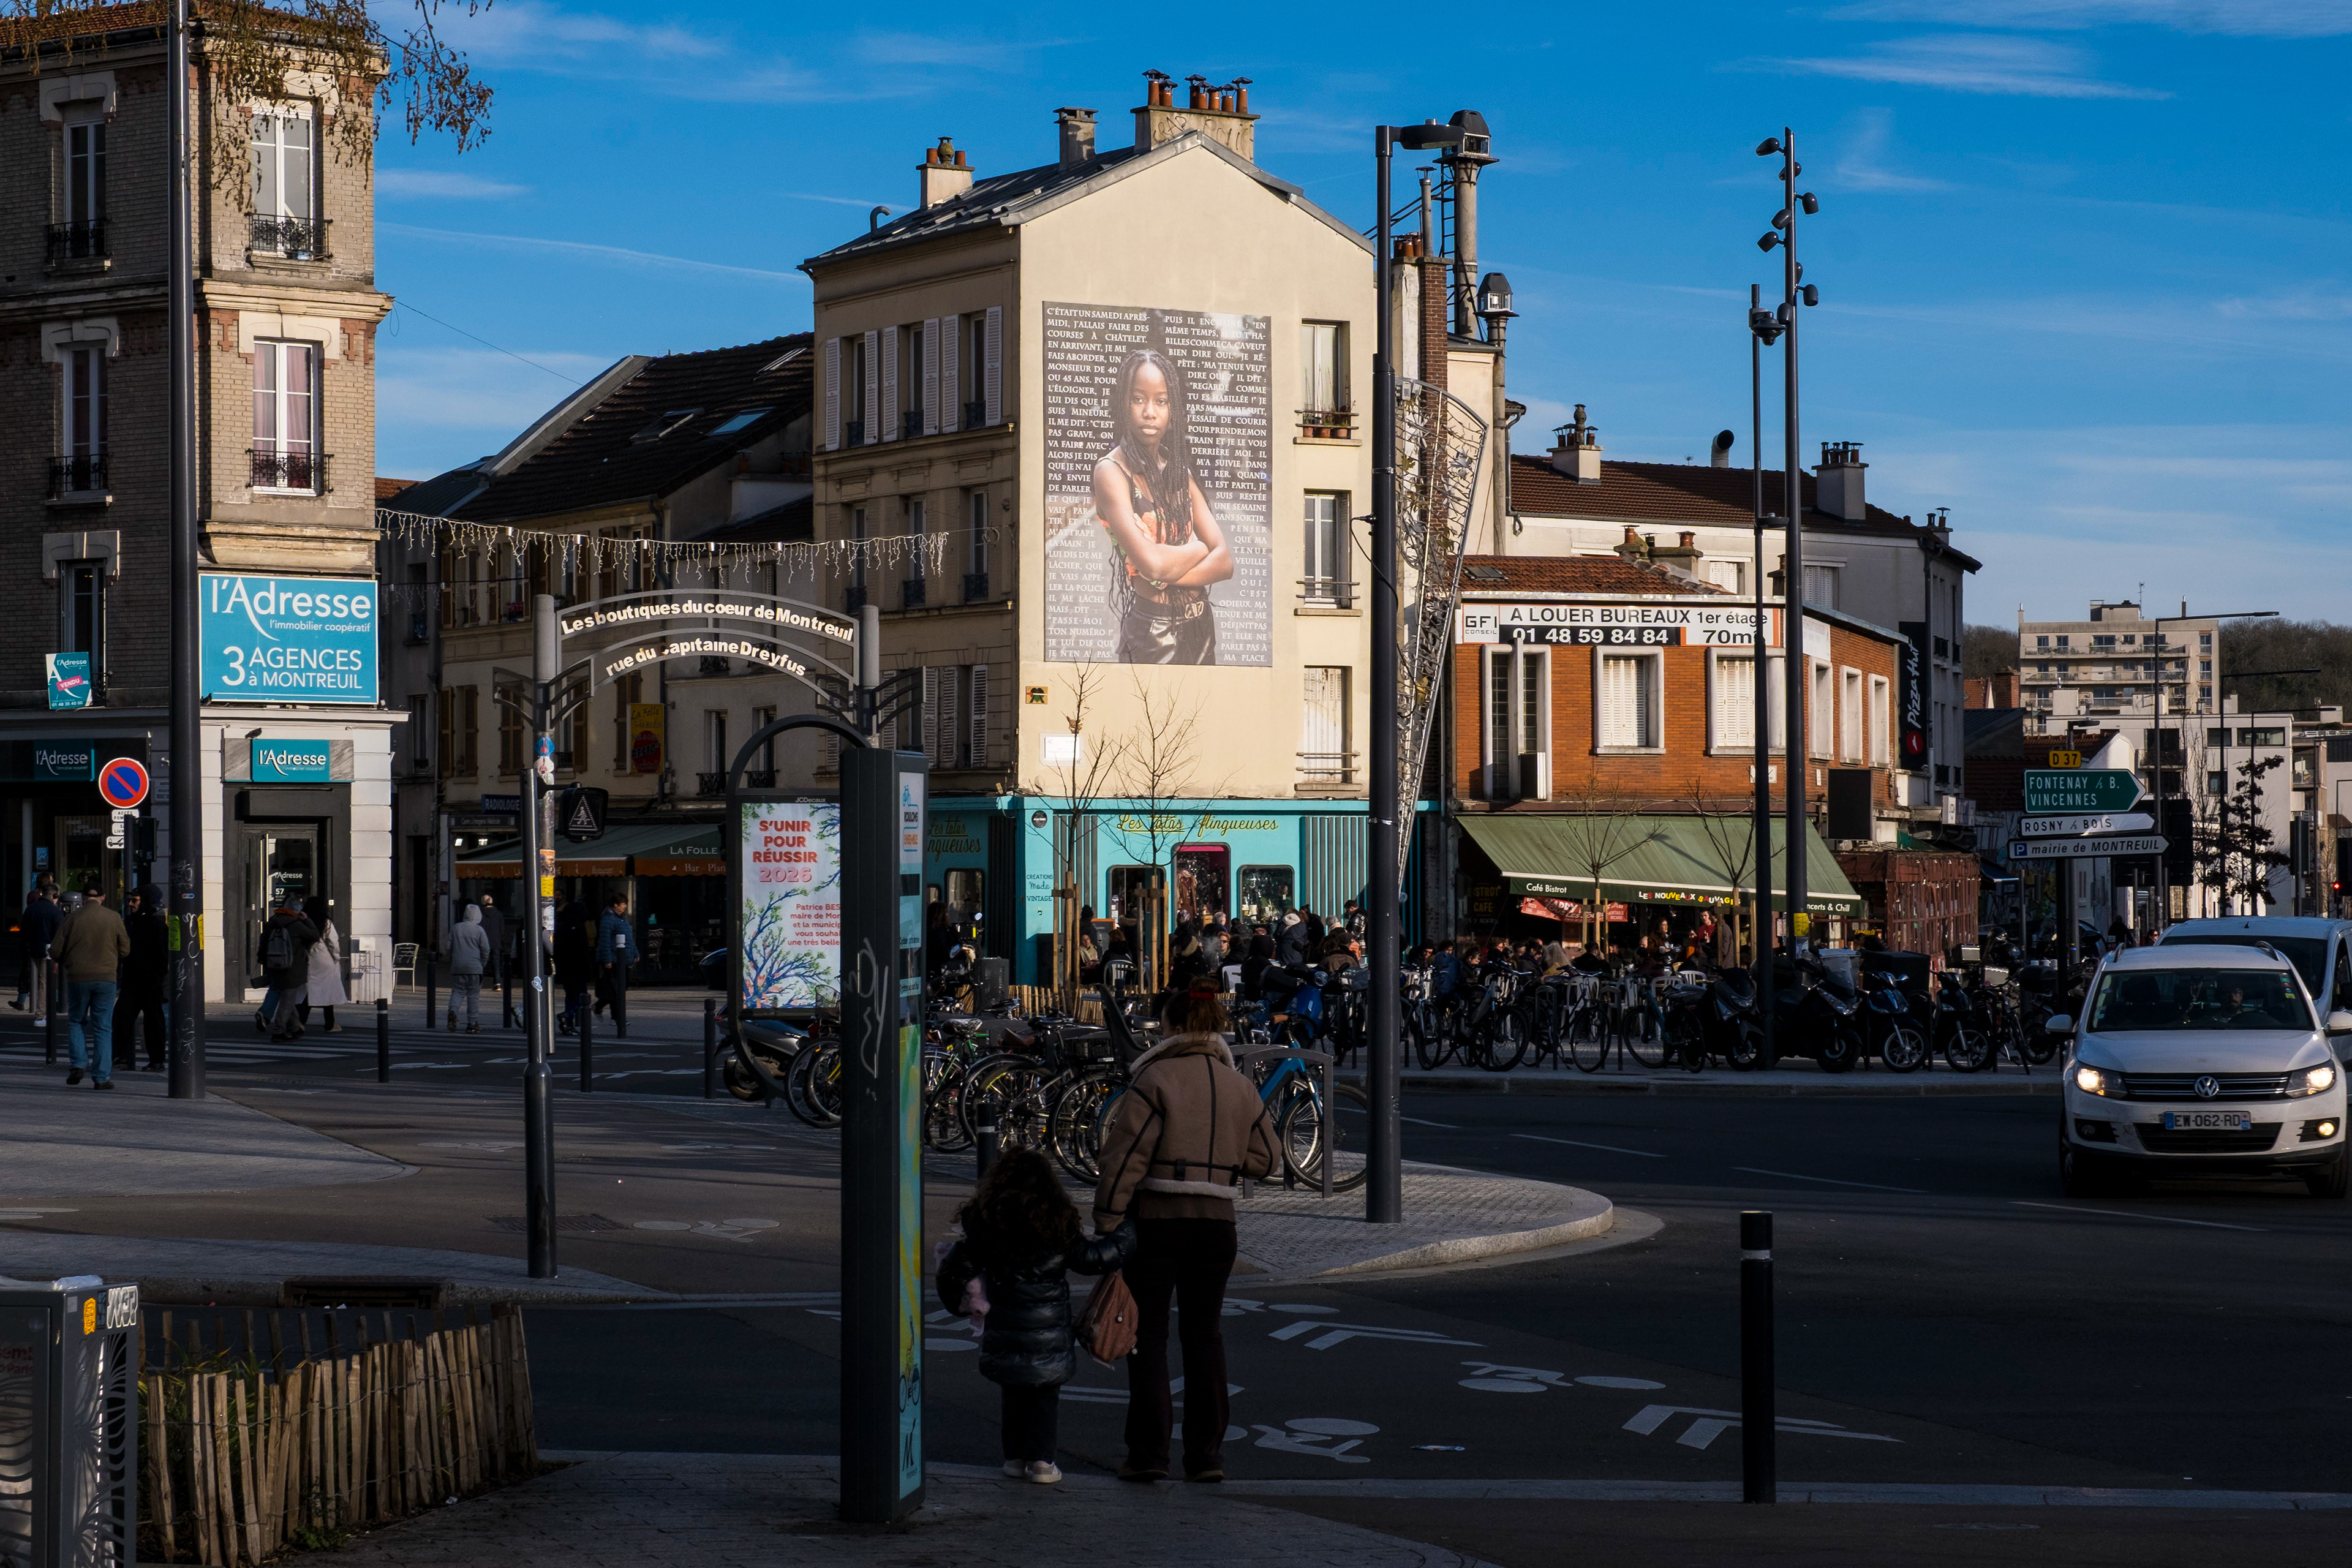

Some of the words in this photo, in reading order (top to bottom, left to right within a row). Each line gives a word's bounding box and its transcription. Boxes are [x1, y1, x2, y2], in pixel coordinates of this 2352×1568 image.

[1047, 307, 1078, 316] C'ÉTAIT
[1047, 319, 1070, 328] MIDI,
[1074, 320, 1105, 329] J'ALLAIS
[1047, 330, 1084, 339] COURSES
[1105, 333, 1147, 343] CHÂTELET.
[1060, 342, 1102, 352] ARRIVANT,
[1066, 353, 1106, 362] ABORDER,
[1048, 363, 1091, 372] MONSIEUR
[212, 577, 371, 639] l'Adresse
[561, 614, 595, 635] Les
[594, 602, 681, 625] boutiques
[682, 600, 703, 614] du
[753, 604, 775, 619] de
[775, 608, 854, 641] Montreuil
[1465, 616, 1497, 628] GFI
[1510, 608, 1523, 621] A
[1529, 608, 1594, 622] LOUER
[1601, 609, 1691, 624] BUREAUX
[1697, 612, 1721, 624] 1er
[270, 619, 322, 631] l'immobilier
[325, 620, 371, 633] coopératif
[1512, 628, 1536, 642] 01
[1545, 628, 1571, 643] 48
[1578, 628, 1604, 644] 59
[1611, 629, 1636, 644] 84
[1643, 629, 1668, 644] 84
[606, 654, 635, 676] rue
[635, 647, 656, 663] du
[658, 638, 739, 656] Capitaine
[740, 641, 806, 676] Dreyfus
[1906, 636, 1920, 677] Hut
[222, 646, 246, 686] 3
[249, 647, 362, 671] AGENCES
[59, 678, 80, 688] VENDU
[249, 671, 257, 686] à
[263, 672, 362, 689] MONTREUIL
[1907, 679, 1922, 729] Pizza
[36, 749, 88, 774] l'Adresse
[258, 748, 326, 775] l'Adresse
[2052, 754, 2059, 765] D
[2064, 753, 2078, 765] 37
[2029, 777, 2088, 789] FONTENAY
[2109, 777, 2119, 788] B.
[484, 798, 520, 810] RADIOLOGIE
[2030, 794, 2097, 806] VINCENNES
[760, 820, 811, 832] S'UNIR
[1117, 813, 1143, 832] Les
[1198, 813, 1279, 837] flingueuses
[2025, 821, 2063, 832] ROSNY
[2083, 818, 2112, 829] BOIS
[764, 836, 806, 846] POUR
[2031, 843, 2067, 854] mairie
[2073, 842, 2086, 853] de
[2091, 840, 2159, 852] MONTREUIL
[752, 848, 818, 862] RÉUSSIR
[685, 863, 699, 872] Bar
[760, 867, 812, 882] 2026
[1028, 881, 1050, 889] Mode
[1526, 883, 1544, 892] Café
[1545, 884, 1567, 894] Bistrot
[1638, 891, 1653, 900] LES
[1654, 892, 1696, 901] NOUVEAUX
[1835, 903, 1850, 913] Chill
[2174, 1114, 2241, 1127] EW-062-RD
